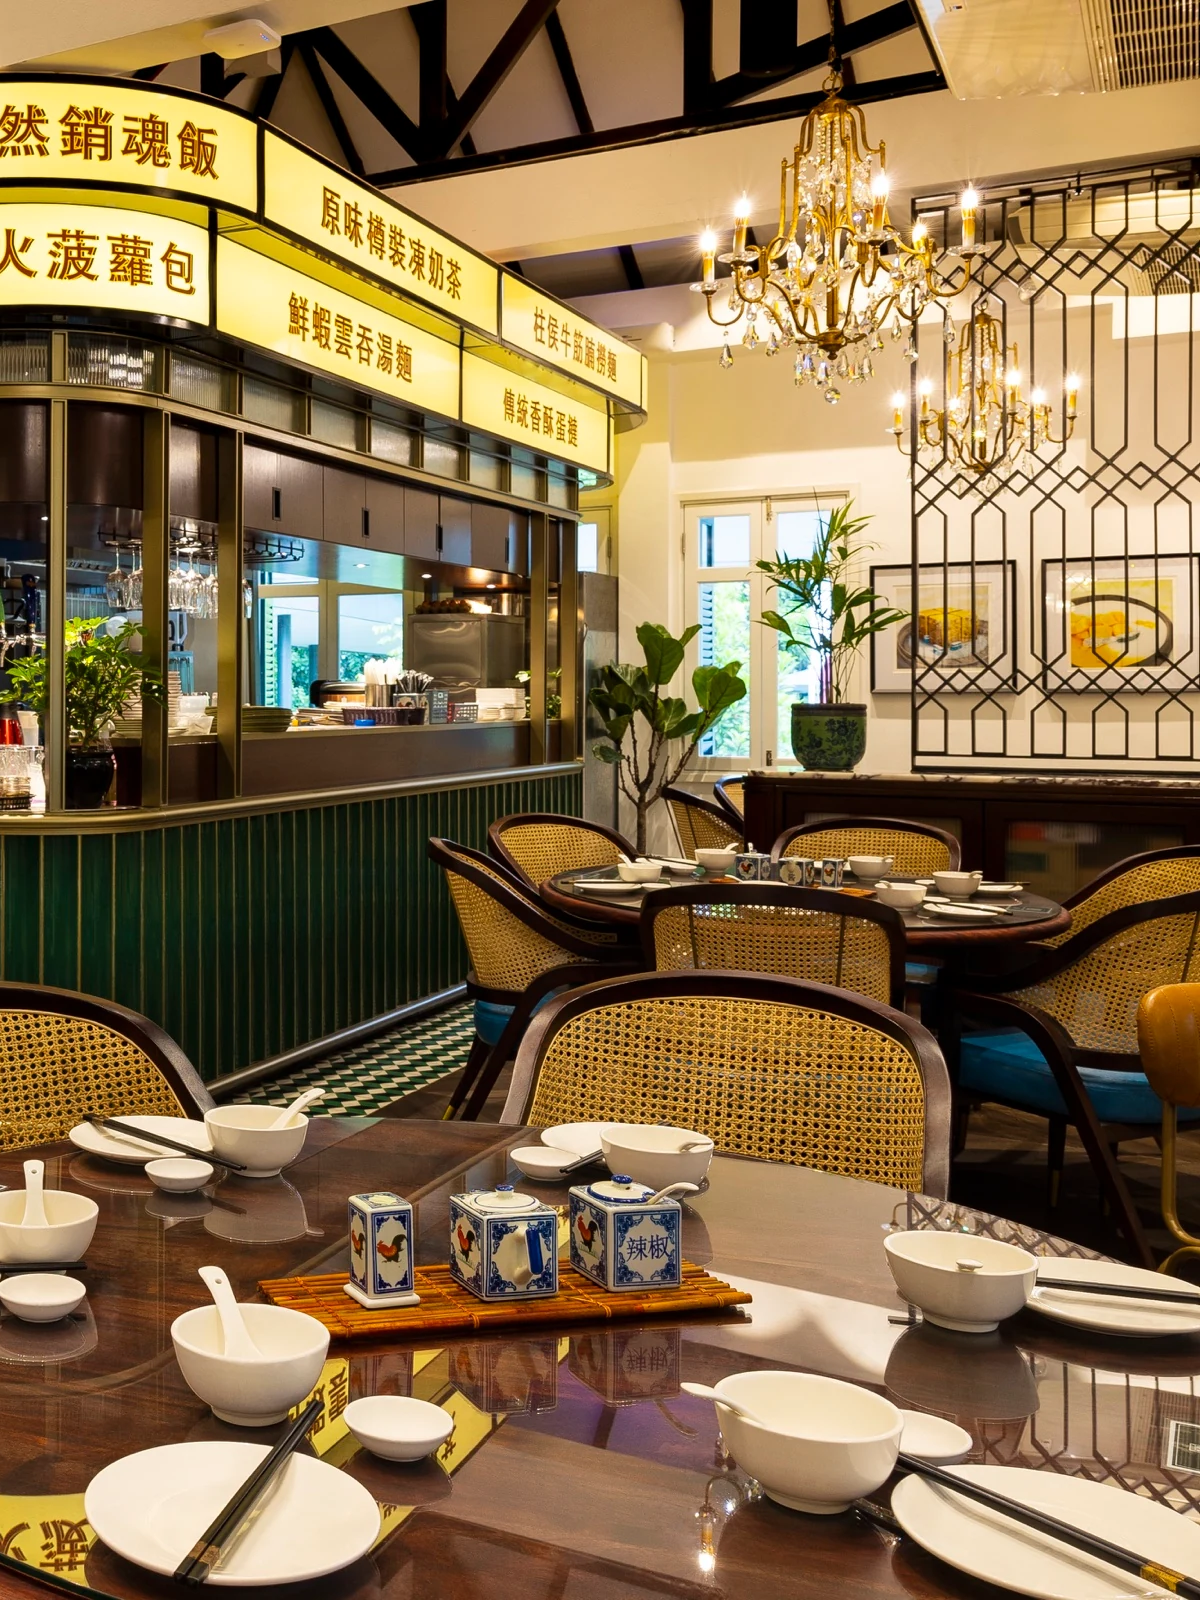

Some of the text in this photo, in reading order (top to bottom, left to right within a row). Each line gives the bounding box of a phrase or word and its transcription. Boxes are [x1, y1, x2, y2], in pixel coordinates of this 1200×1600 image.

[321, 186, 462, 300] 原味樽裝凍奶茶
[288, 291, 413, 383] 鮮蝦雲吞湯麵
[626, 1234, 671, 1261] 辣椒
